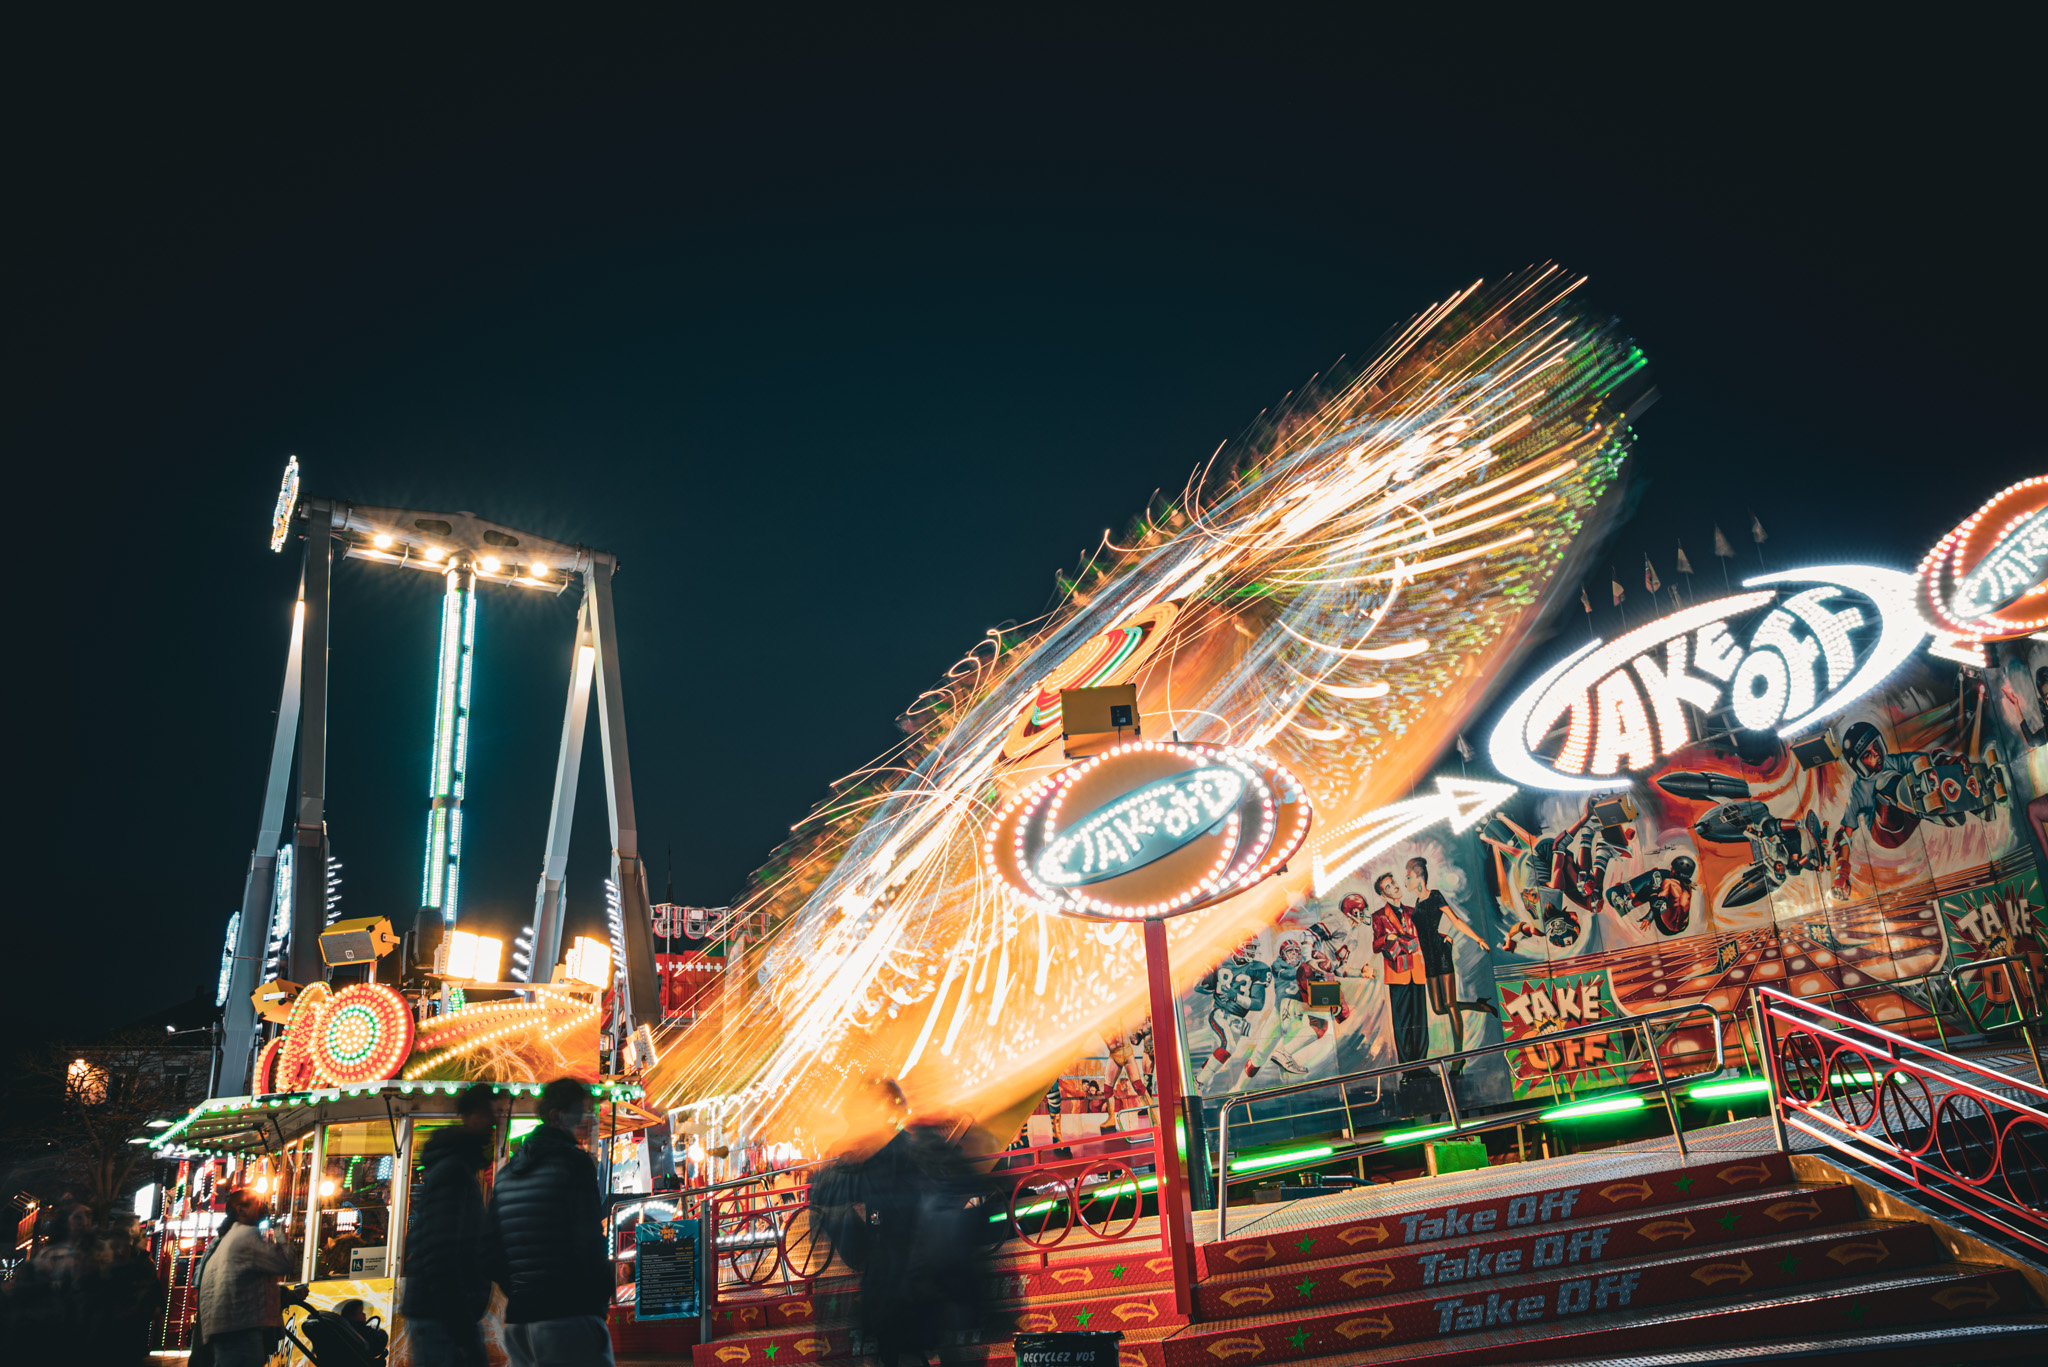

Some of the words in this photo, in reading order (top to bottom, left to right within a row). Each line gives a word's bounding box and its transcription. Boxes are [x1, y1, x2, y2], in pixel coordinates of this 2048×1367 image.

[1523, 592, 1776, 775] TAKE
[1731, 585, 1864, 732] OFF
[1050, 785, 1175, 871] TAKE
[1957, 898, 2033, 945] TAKE
[1505, 985, 1602, 1025] TAKE
[1400, 1207, 1498, 1244] Take
[1506, 1188, 1581, 1229] Off
[1417, 1247, 1523, 1285] Take
[1532, 1227, 1612, 1269] Off
[1433, 1293, 1547, 1334] Take
[1556, 1271, 1642, 1315] Off
[1023, 1351, 1071, 1364] RECYCLEZ
[1076, 1350, 1096, 1363] VOS
